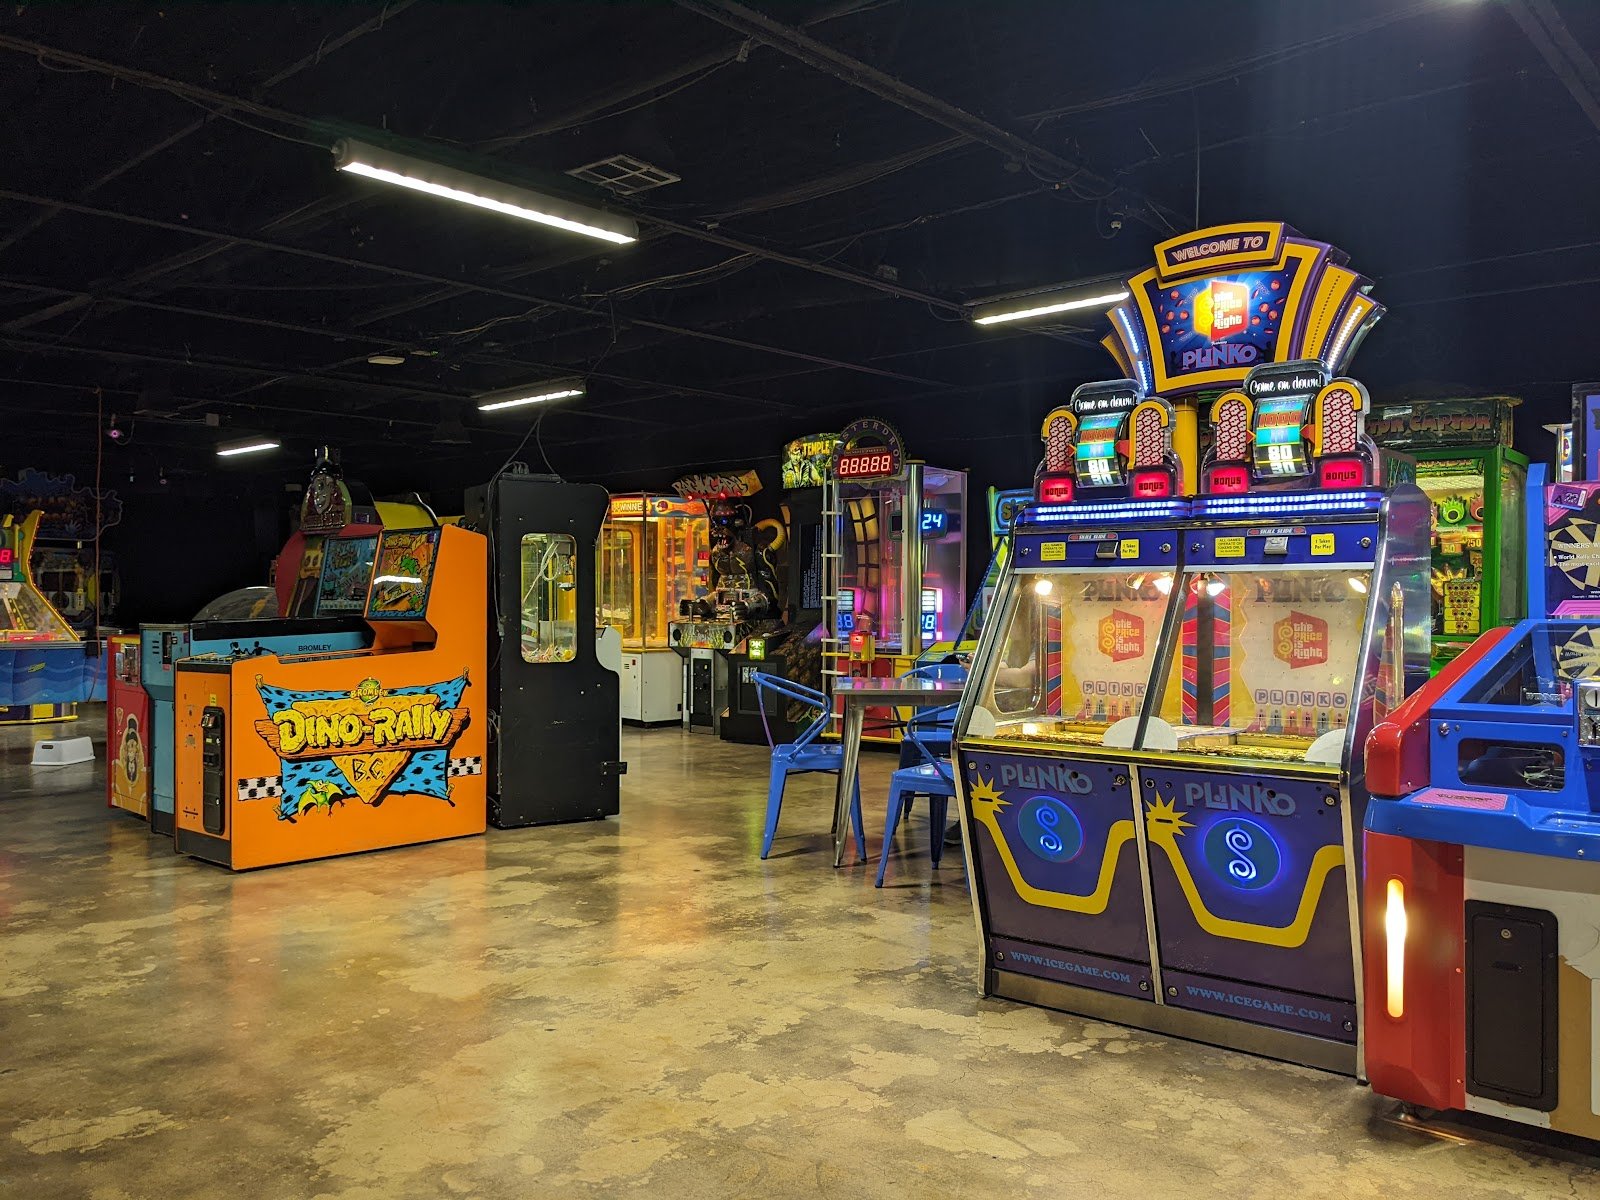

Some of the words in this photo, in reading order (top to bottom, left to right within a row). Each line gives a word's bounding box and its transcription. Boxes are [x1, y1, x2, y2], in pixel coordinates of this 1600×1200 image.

[1172, 238, 1240, 261] WELCOME
[1243, 235, 1264, 249] TO
[1182, 343, 1257, 370] PLINKO
[1250, 380, 1275, 395] Come
[1278, 381, 1290, 391] on
[1292, 375, 1322, 389] down!
[1074, 399, 1096, 413] Come
[1098, 400, 1109, 408] on
[1110, 394, 1135, 408] down!
[1409, 412, 1491, 432] CAPTOR
[803, 440, 830, 456] TEMPLE
[1116, 619, 1132, 629] the
[1294, 622, 1313, 632] the
[298, 644, 332, 652] BROMLEY
[1116, 635, 1124, 644] is
[1116, 642, 1140, 654] Right
[1294, 640, 1303, 649] is
[1294, 646, 1322, 659] Right
[350, 688, 389, 700] BROMLEY
[1083, 681, 1146, 697] PLINK
[1255, 689, 1347, 708] PLINKO
[1001, 763, 1093, 795] PLINKO
[1184, 782, 1296, 816] PLINKO
[1011, 951, 1130, 983] WWW.ICEGAME.COM
[1186, 985, 1332, 1023] WWW.ICEGAME.COM
